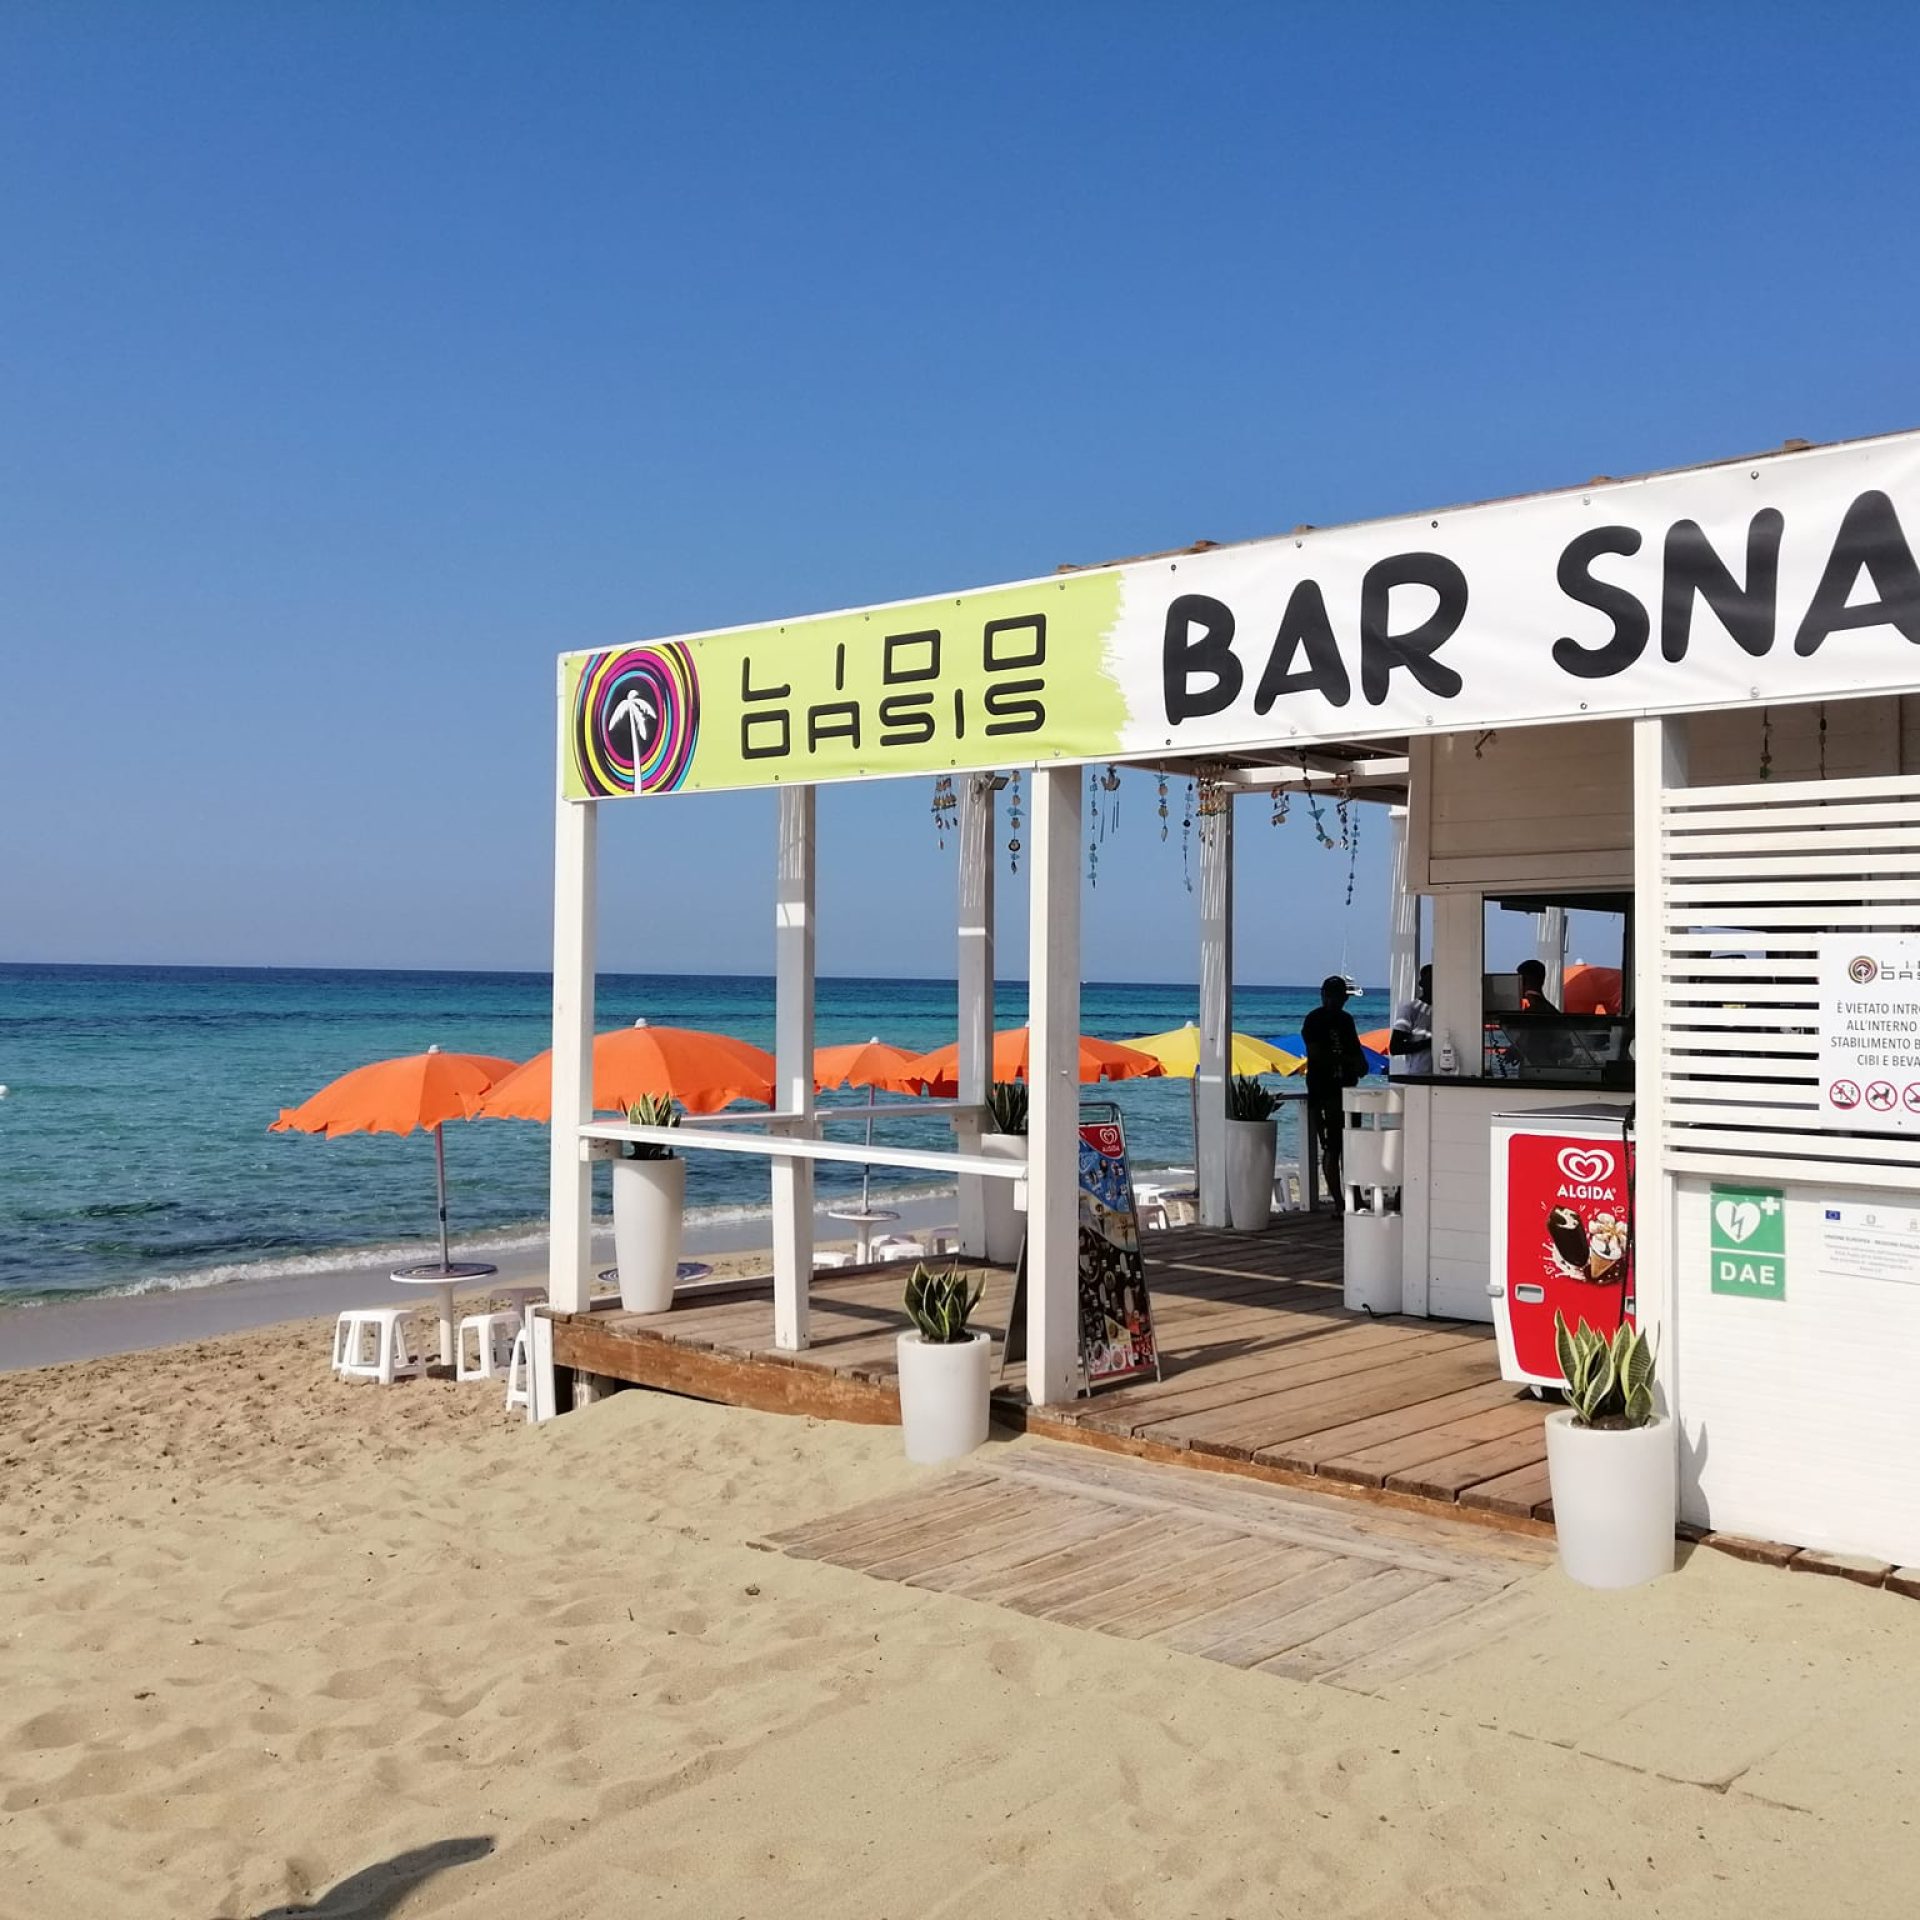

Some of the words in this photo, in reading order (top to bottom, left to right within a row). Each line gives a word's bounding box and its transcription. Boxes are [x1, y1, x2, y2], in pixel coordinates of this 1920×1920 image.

[1163, 552, 1469, 726] BAR
[1552, 489, 1920, 678] SNA
[741, 613, 1047, 702] LIDO
[741, 678, 1047, 760] OASIS
[1881, 960, 1920, 969] LI
[1845, 1002, 1889, 1014] VIETATO
[1893, 1003, 1920, 1015] INTR
[1847, 1019, 1917, 1032] ALL'INTERNO
[1830, 1035, 1910, 1050] STABILIMENTO
[1857, 1054, 1880, 1066] CIBI
[1882, 1055, 1889, 1066] E
[1557, 1184, 1615, 1201] ALGIDA
[1720, 1261, 1776, 1286] DAE
